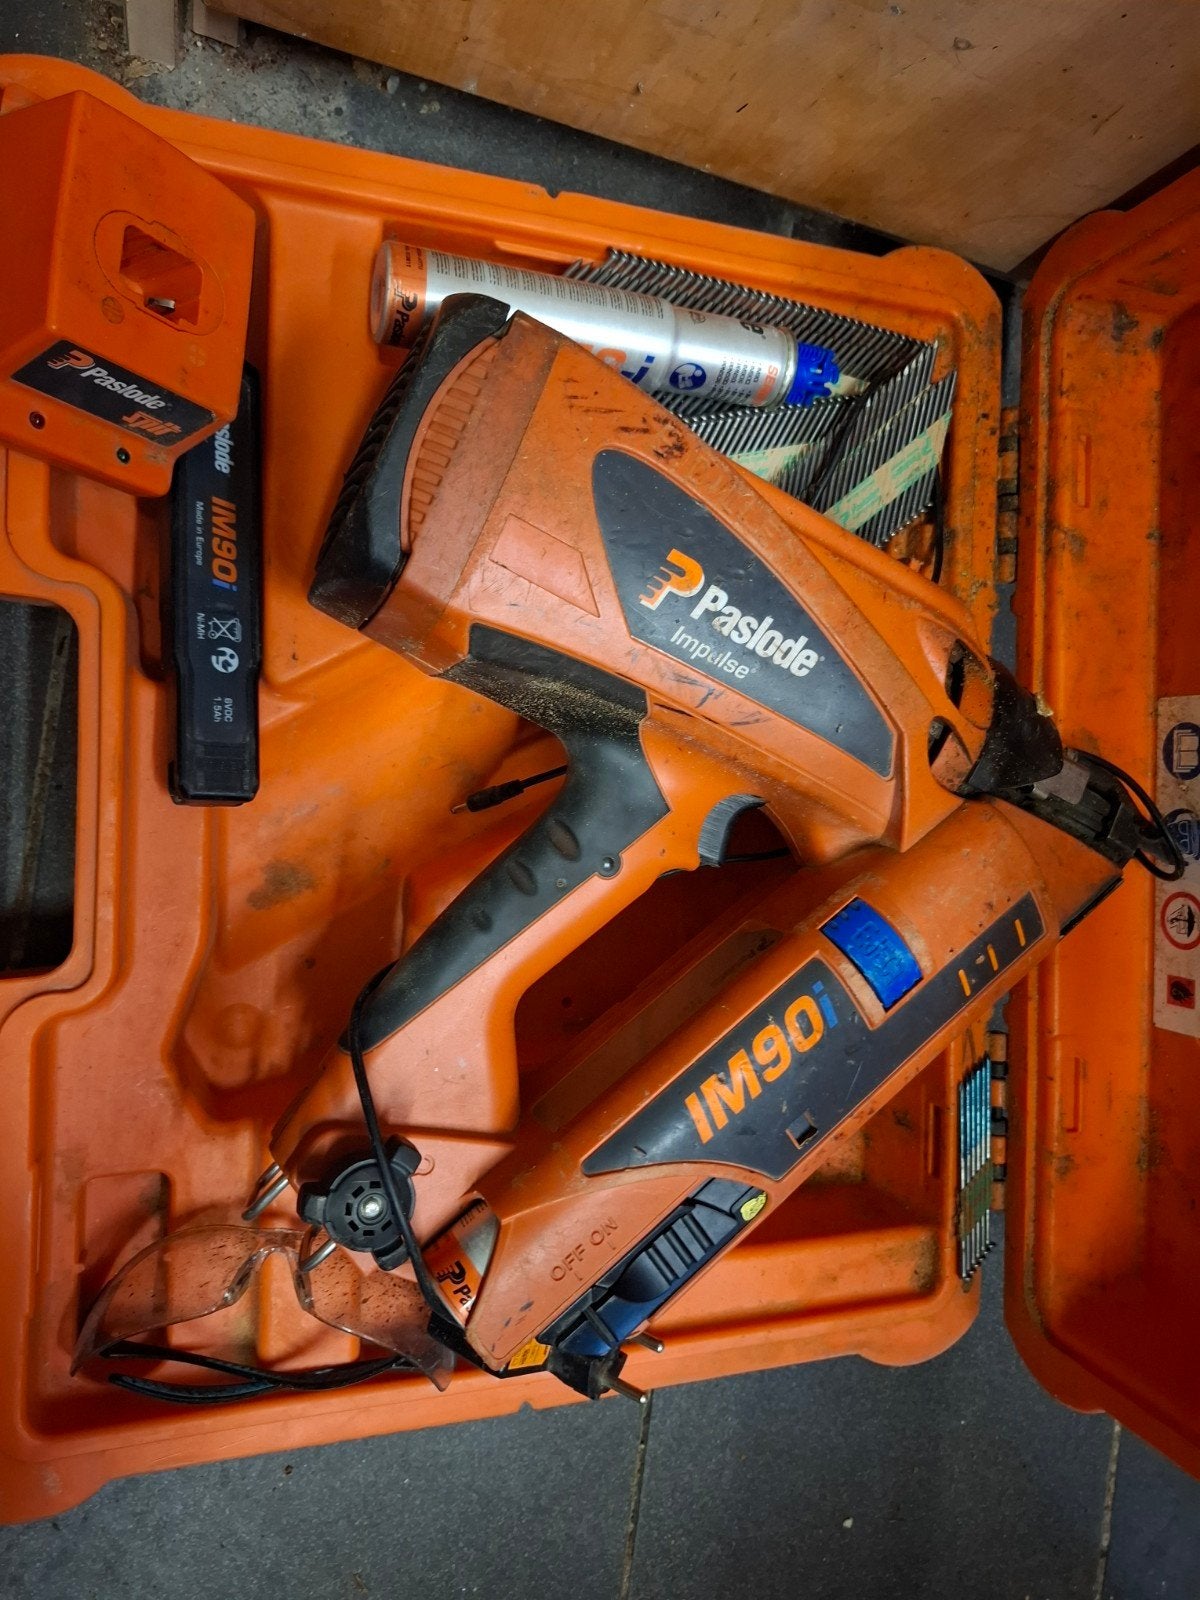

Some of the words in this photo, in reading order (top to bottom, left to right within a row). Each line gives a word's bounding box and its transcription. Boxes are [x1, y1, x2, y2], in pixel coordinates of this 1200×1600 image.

[80, 366, 166, 410] Paslode
[195, 501, 204, 525] Made
[194, 536, 205, 566] Europe
[211, 496, 238, 592] IM90i
[669, 626, 750, 680] Impulse
[689, 584, 819, 678] Paslode
[224, 698, 233, 723] 6VDC
[684, 980, 839, 1145] IM90i
[550, 1243, 586, 1282] OFF
[589, 1216, 619, 1246] ON
